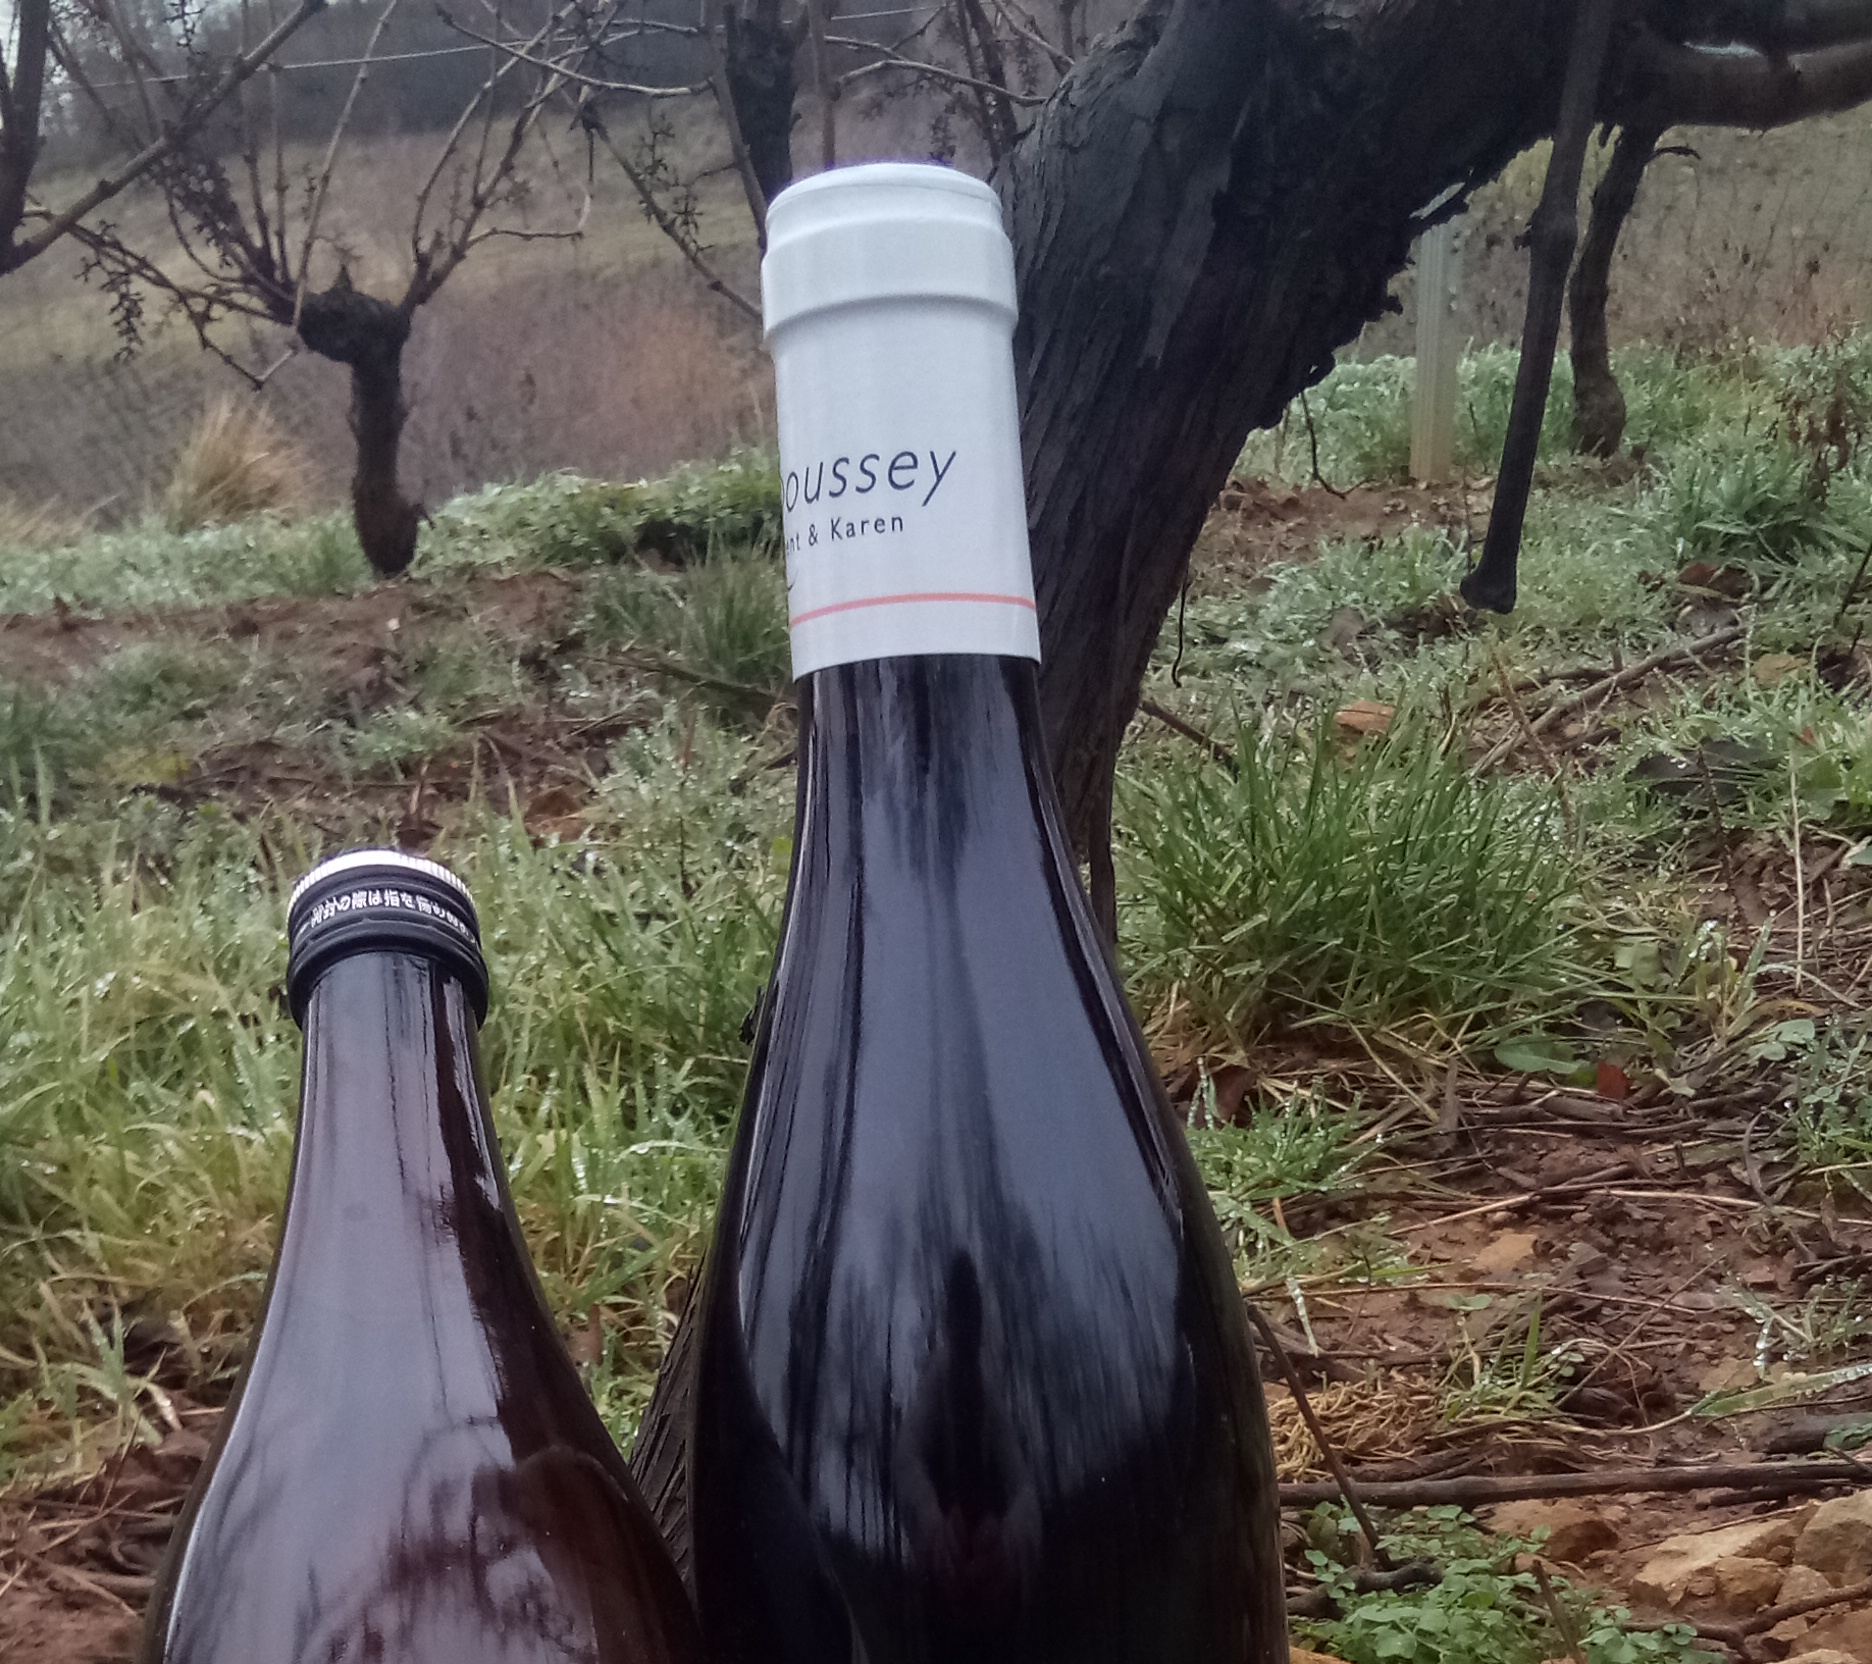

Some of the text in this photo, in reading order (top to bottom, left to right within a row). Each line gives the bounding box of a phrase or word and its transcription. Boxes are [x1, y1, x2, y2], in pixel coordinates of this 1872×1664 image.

[781, 449, 957, 512] oussey
[808, 523, 819, 547] &
[830, 515, 903, 542] Karen
